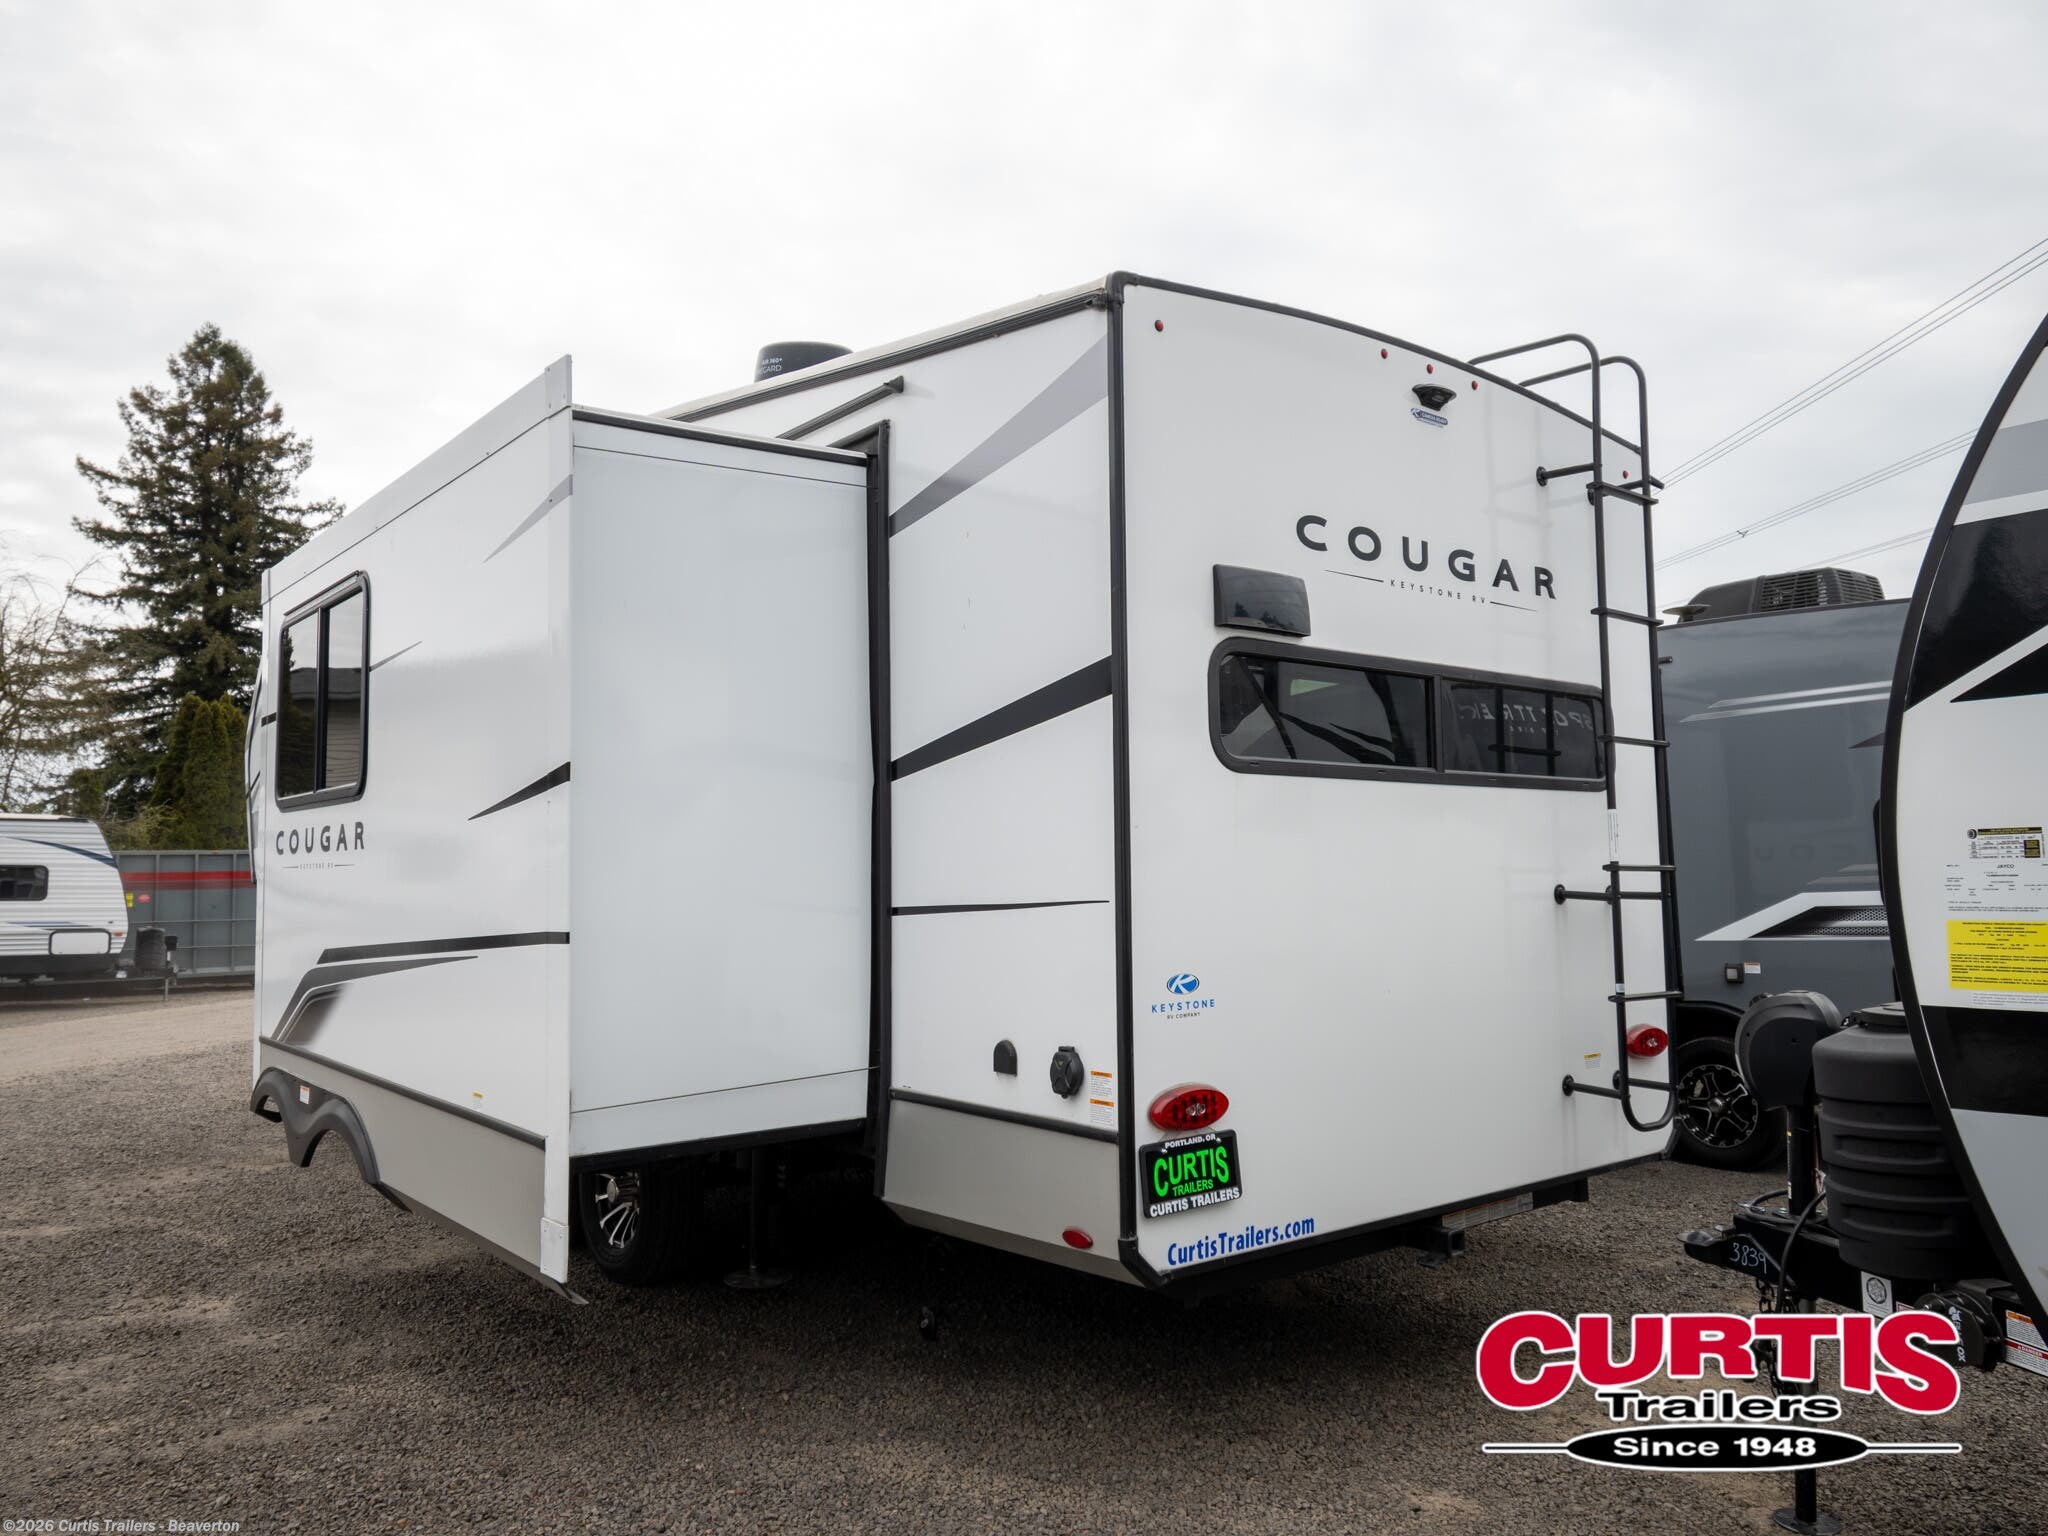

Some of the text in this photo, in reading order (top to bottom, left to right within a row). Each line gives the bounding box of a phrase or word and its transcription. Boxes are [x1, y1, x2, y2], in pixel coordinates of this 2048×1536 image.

[1296, 515, 1556, 600] COUGAR
[1390, 579, 1461, 600] KEYSTONE
[275, 821, 365, 856] COUGAR
[1151, 998, 1216, 1014] KEYSTONE
[1175, 1011, 1201, 1020] COMPANY
[1205, 1133, 1216, 1141] OR
[1154, 1146, 1230, 1197] CURTIS
[1150, 1187, 1240, 1218] CURTIS TRAILERS
[1172, 1178, 1214, 1197] TRAILERS
[1167, 1217, 1315, 1266] CurtisTrailers.com
[1729, 1242, 1768, 1275] 3839
